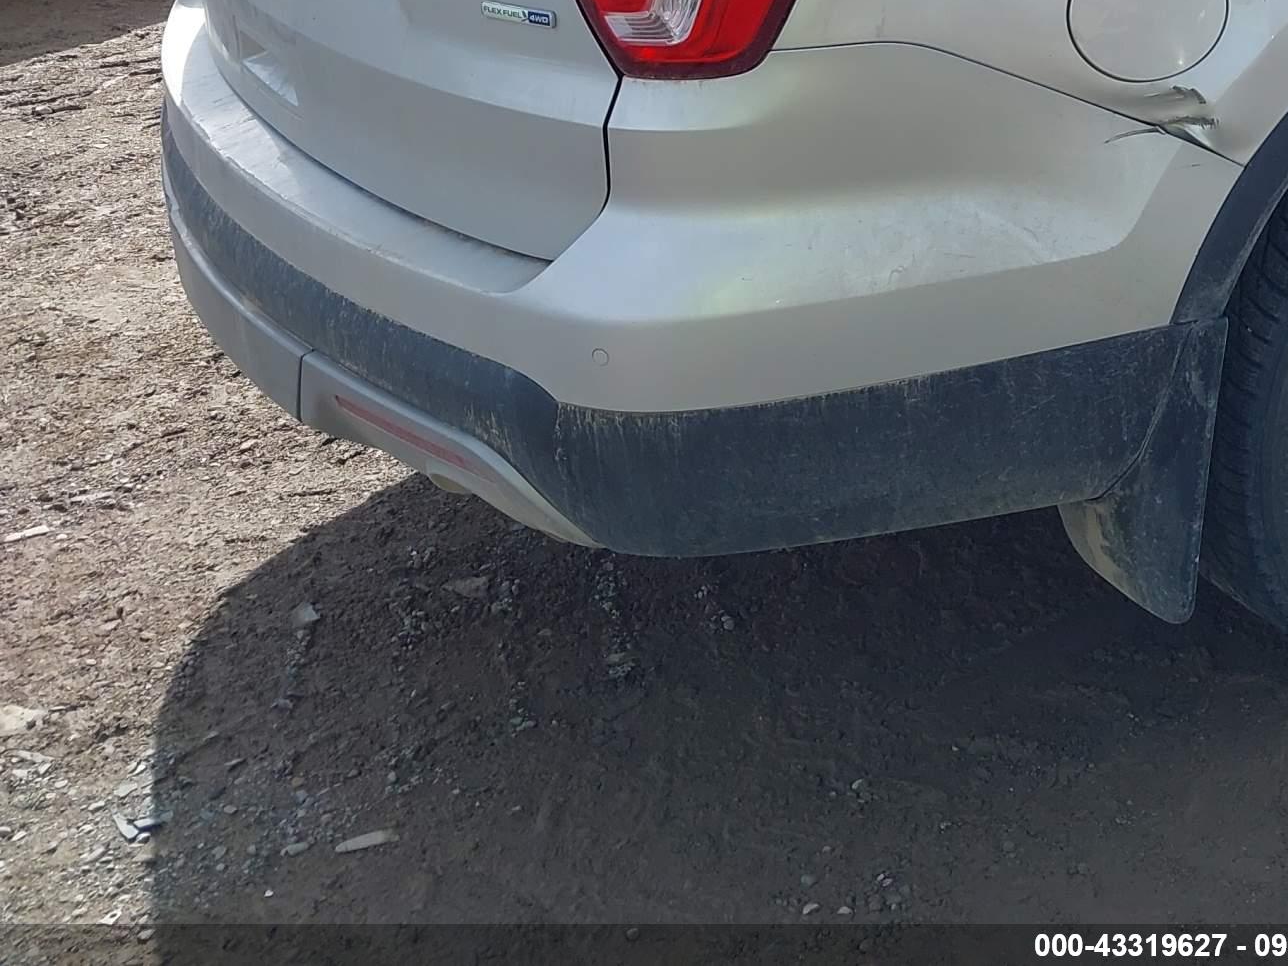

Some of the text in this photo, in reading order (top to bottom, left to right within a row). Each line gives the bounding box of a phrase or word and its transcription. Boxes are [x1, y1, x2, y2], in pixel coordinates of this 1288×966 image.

[483, 5, 549, 24] FLEX FUEL 4WD
